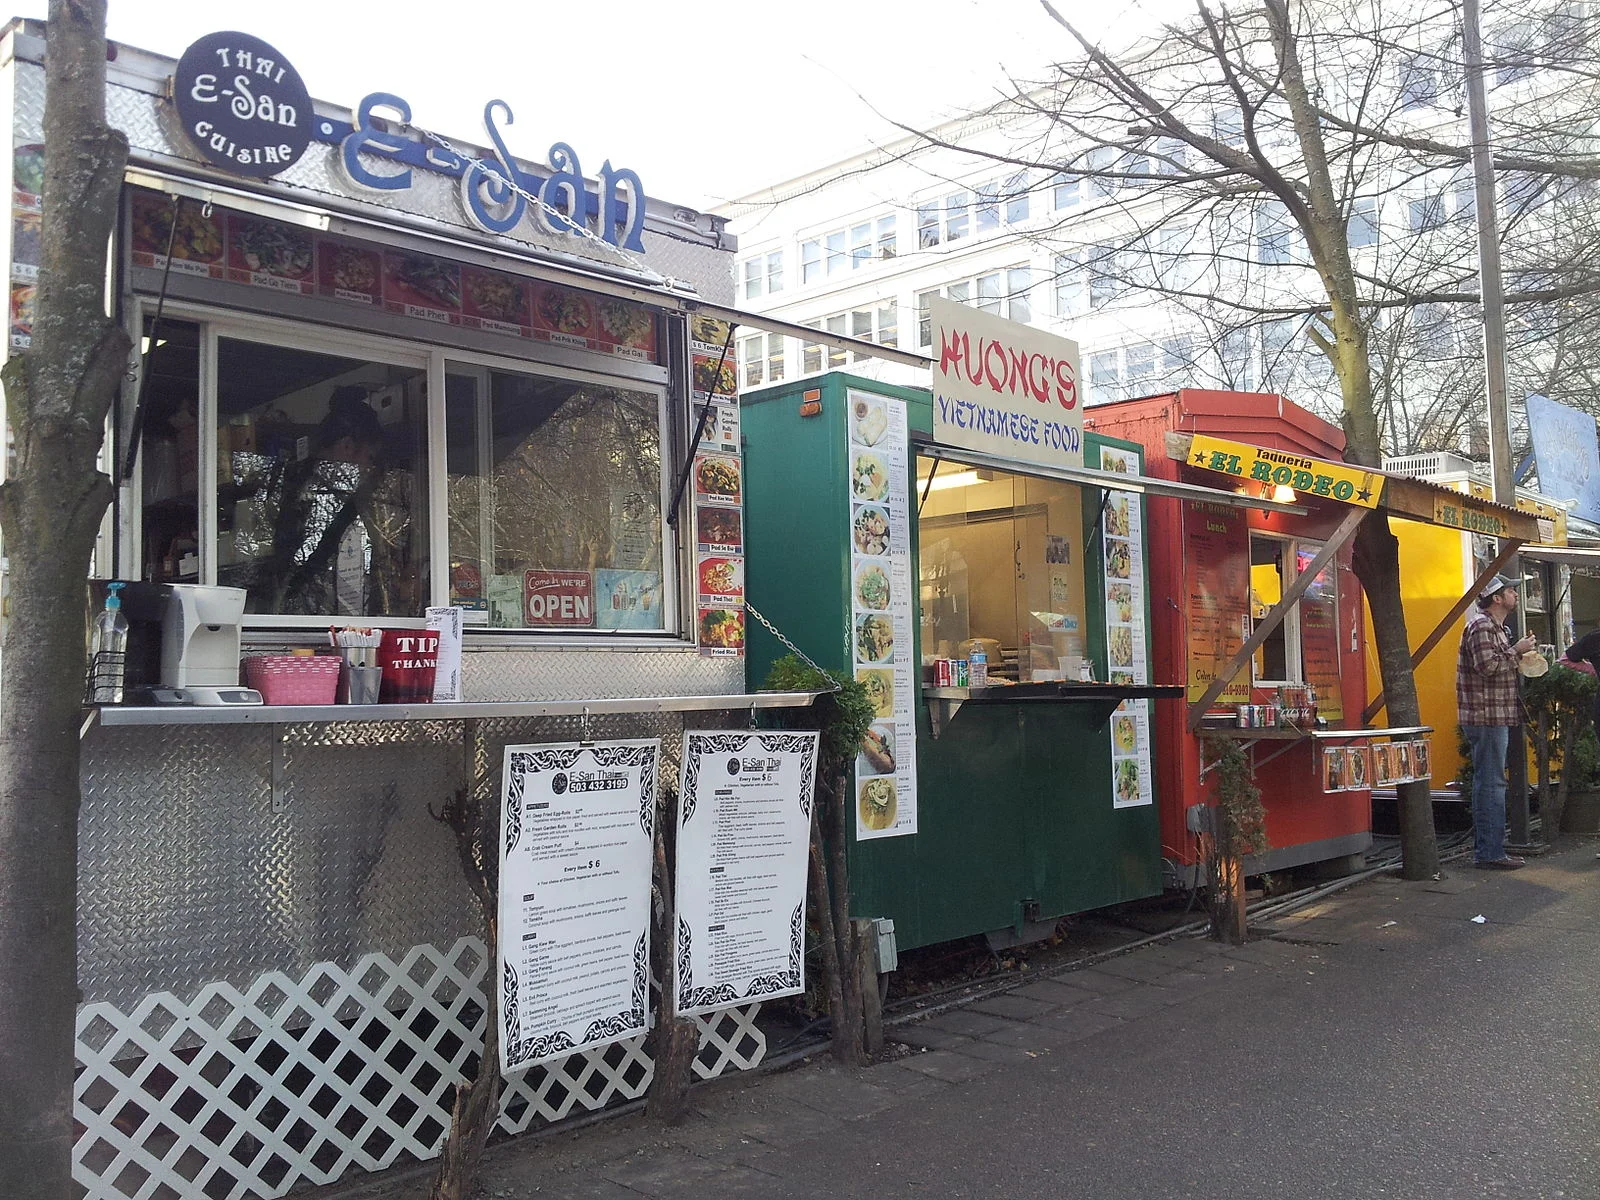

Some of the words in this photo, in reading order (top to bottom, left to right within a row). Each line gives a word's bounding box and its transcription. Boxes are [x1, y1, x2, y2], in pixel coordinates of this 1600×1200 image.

[216, 47, 287, 84] THAI
[190, 74, 297, 127] E-San
[340, 91, 647, 254] E-San
[410, 306, 425, 317] Pad
[427, 310, 445, 321] Phet
[617, 346, 630, 356] Pad
[940, 325, 1077, 410] HUONG'S
[938, 394, 1039, 444] VIETNAMESE
[1044, 421, 1079, 453] FOOD
[1208, 451, 1242, 476] EL
[1250, 460, 1354, 502] RODEO
[1206, 520, 1227, 533] Lunch
[1443, 505, 1458, 527] EL
[1462, 509, 1502, 535] RODEO
[529, 577, 550, 590] Come
[561, 579, 586, 588] WE'RE
[529, 594, 589, 619] OPEN
[396, 637, 439, 653] TIP
[742, 757, 766, 768] E-San
[767, 757, 782, 768] Thai
[569, 771, 595, 783] E-San
[597, 768, 615, 781] Thai
[570, 782, 587, 793] 503
[589, 780, 605, 791] 432
[606, 779, 628, 790] 3199
